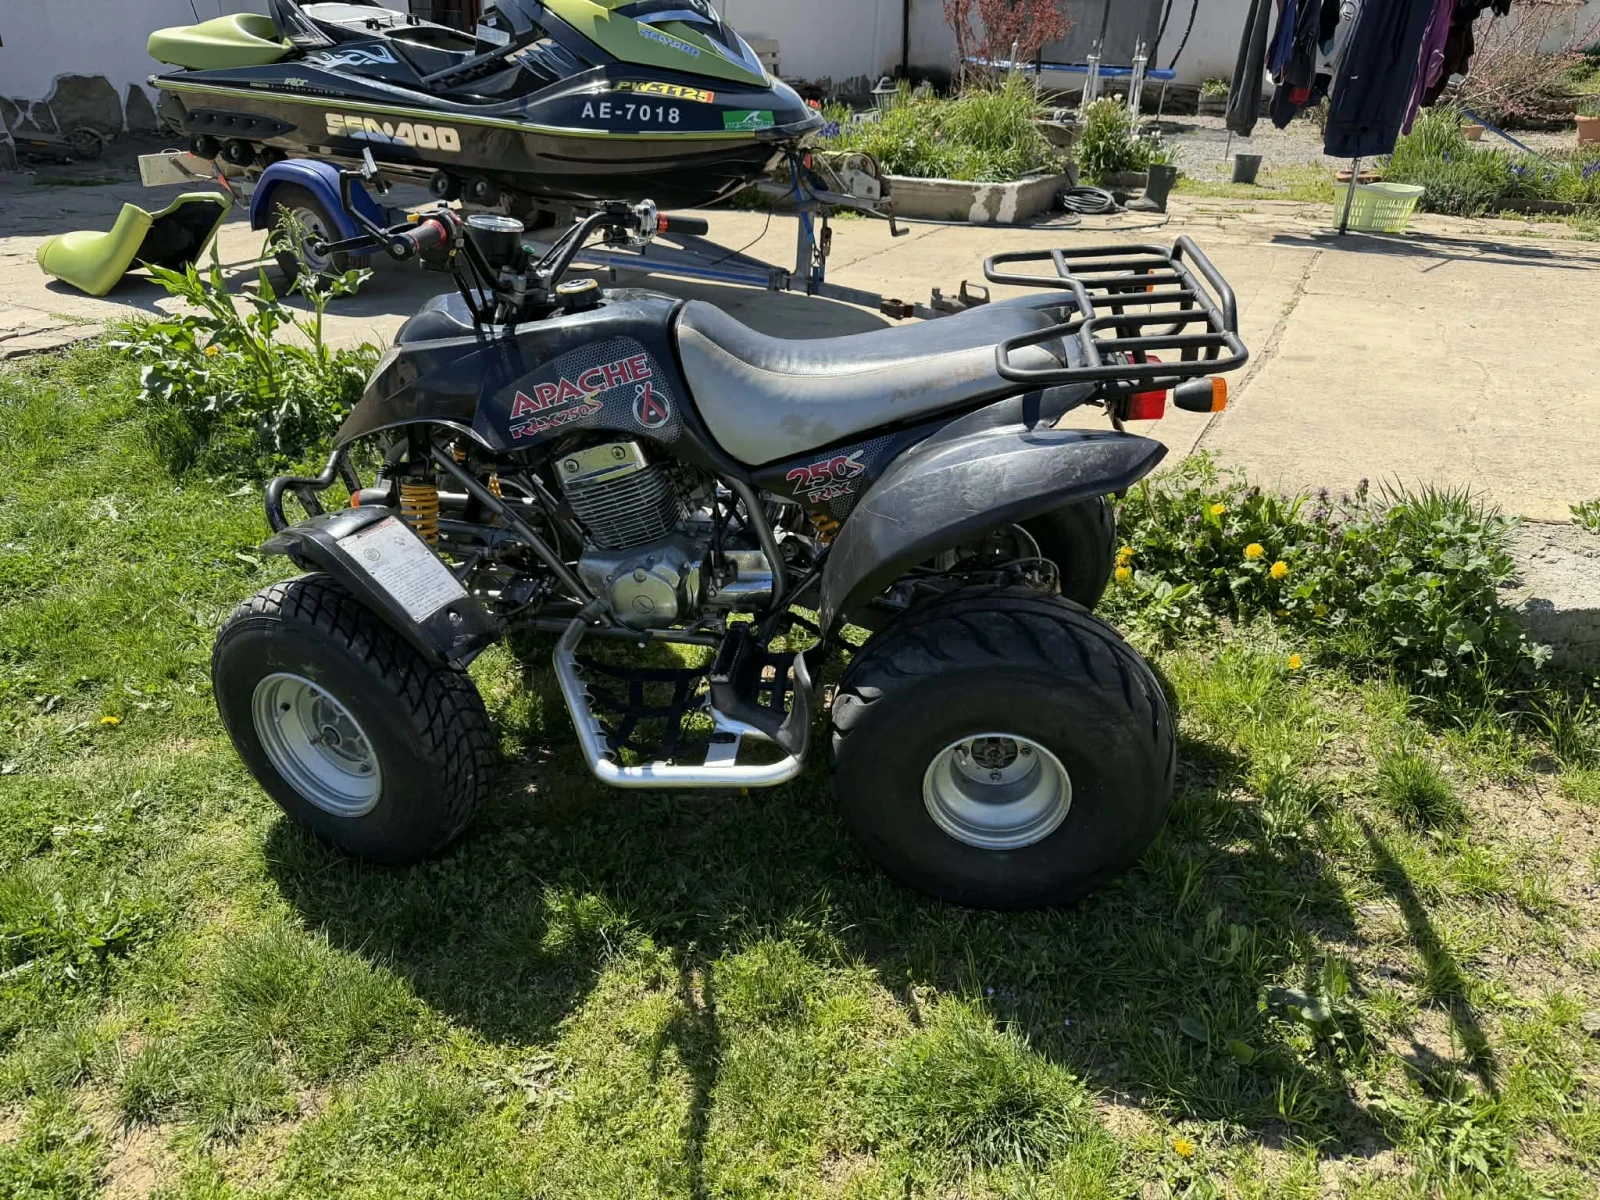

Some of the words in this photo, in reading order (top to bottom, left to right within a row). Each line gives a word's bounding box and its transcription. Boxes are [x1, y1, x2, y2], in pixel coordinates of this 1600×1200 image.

[616, 80, 708, 102] PW-1125
[581, 101, 680, 124] AE-7018
[510, 353, 652, 420] APACHE
[786, 449, 864, 495] 250S
